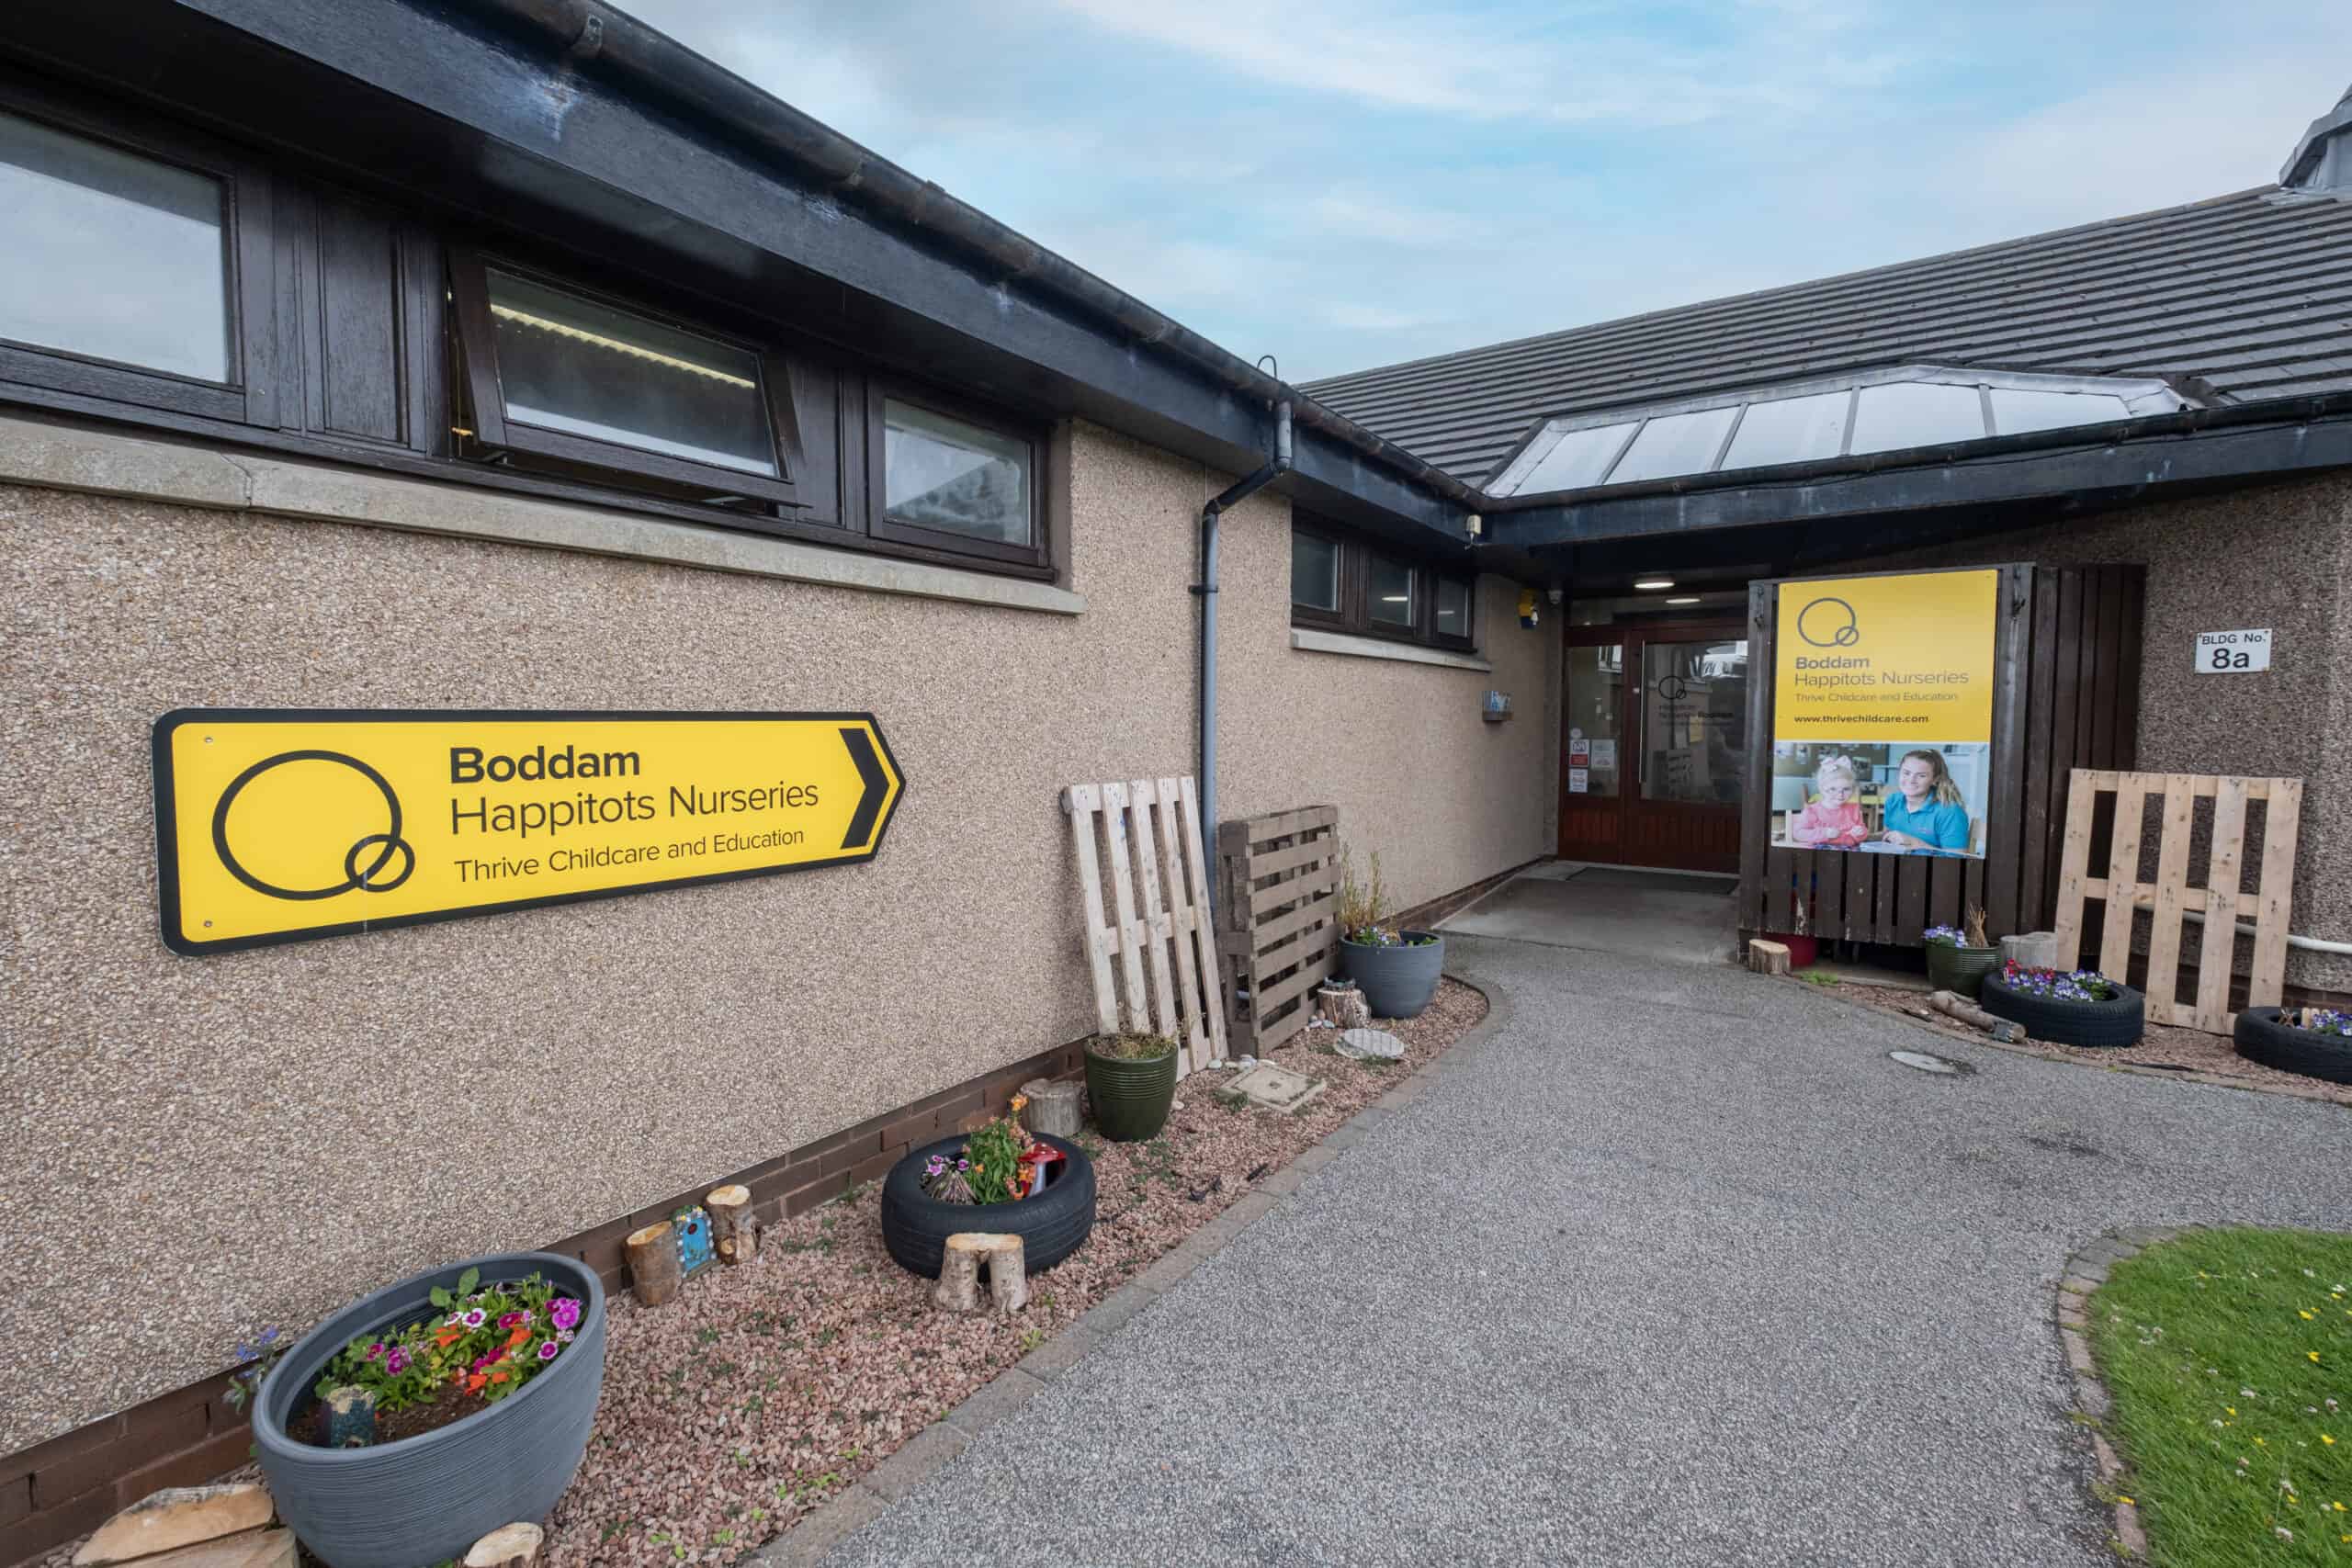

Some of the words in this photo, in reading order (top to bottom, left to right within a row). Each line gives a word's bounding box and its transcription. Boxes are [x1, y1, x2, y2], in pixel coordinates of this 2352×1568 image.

[2202, 635, 2237, 645] BLDG
[1795, 656, 1870, 670] Boddam
[2211, 648, 2250, 669] 8a
[1794, 671, 1875, 689] Happitots
[1882, 670, 1970, 685] Nurseries
[1795, 693, 1826, 703] Thrive
[1828, 693, 1877, 703] Childcare
[1880, 694, 1900, 702] and
[1903, 693, 1957, 702] Education
[1794, 714, 1929, 724] www.thrivechildcare.com
[449, 745, 640, 784] Boddam
[451, 791, 656, 839] Happitots
[669, 781, 819, 818] Nurseries
[455, 854, 539, 883] Thrive
[548, 842, 661, 872] Childcare
[667, 837, 707, 860] and
[713, 828, 805, 853] Education
